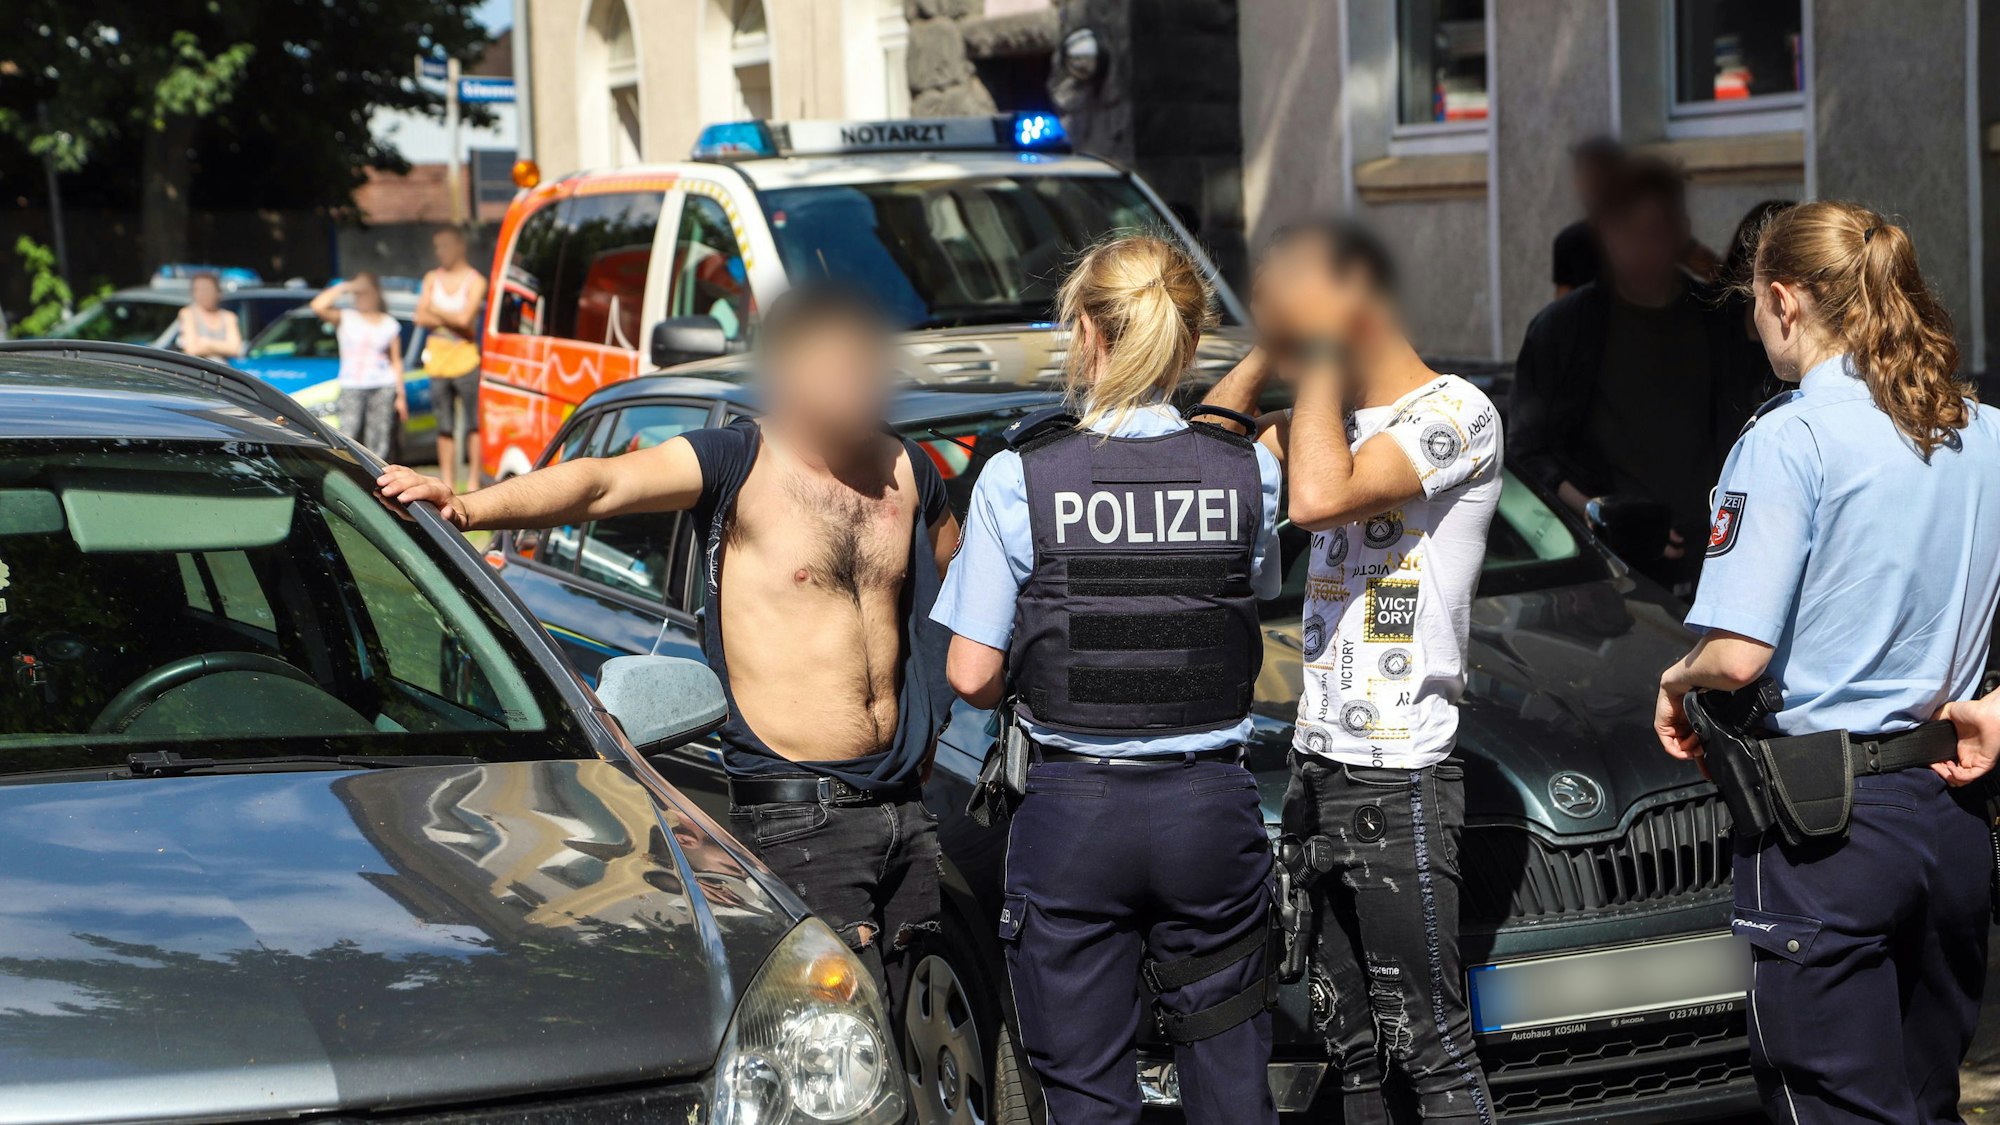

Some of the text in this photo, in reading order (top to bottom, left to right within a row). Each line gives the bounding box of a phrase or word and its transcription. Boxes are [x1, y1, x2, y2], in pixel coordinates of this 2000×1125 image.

[841, 124, 946, 143] NOTARZT
[1054, 489, 1239, 544] POLIZEI
[1378, 597, 1417, 611] VICT
[1377, 611, 1414, 625] ORY
[1341, 639, 1354, 691] VICTORY
[1318, 672, 1329, 723] VICTORY
[1511, 1029, 1552, 1041] Autohaus
[1555, 1023, 1587, 1036] KOSIAN
